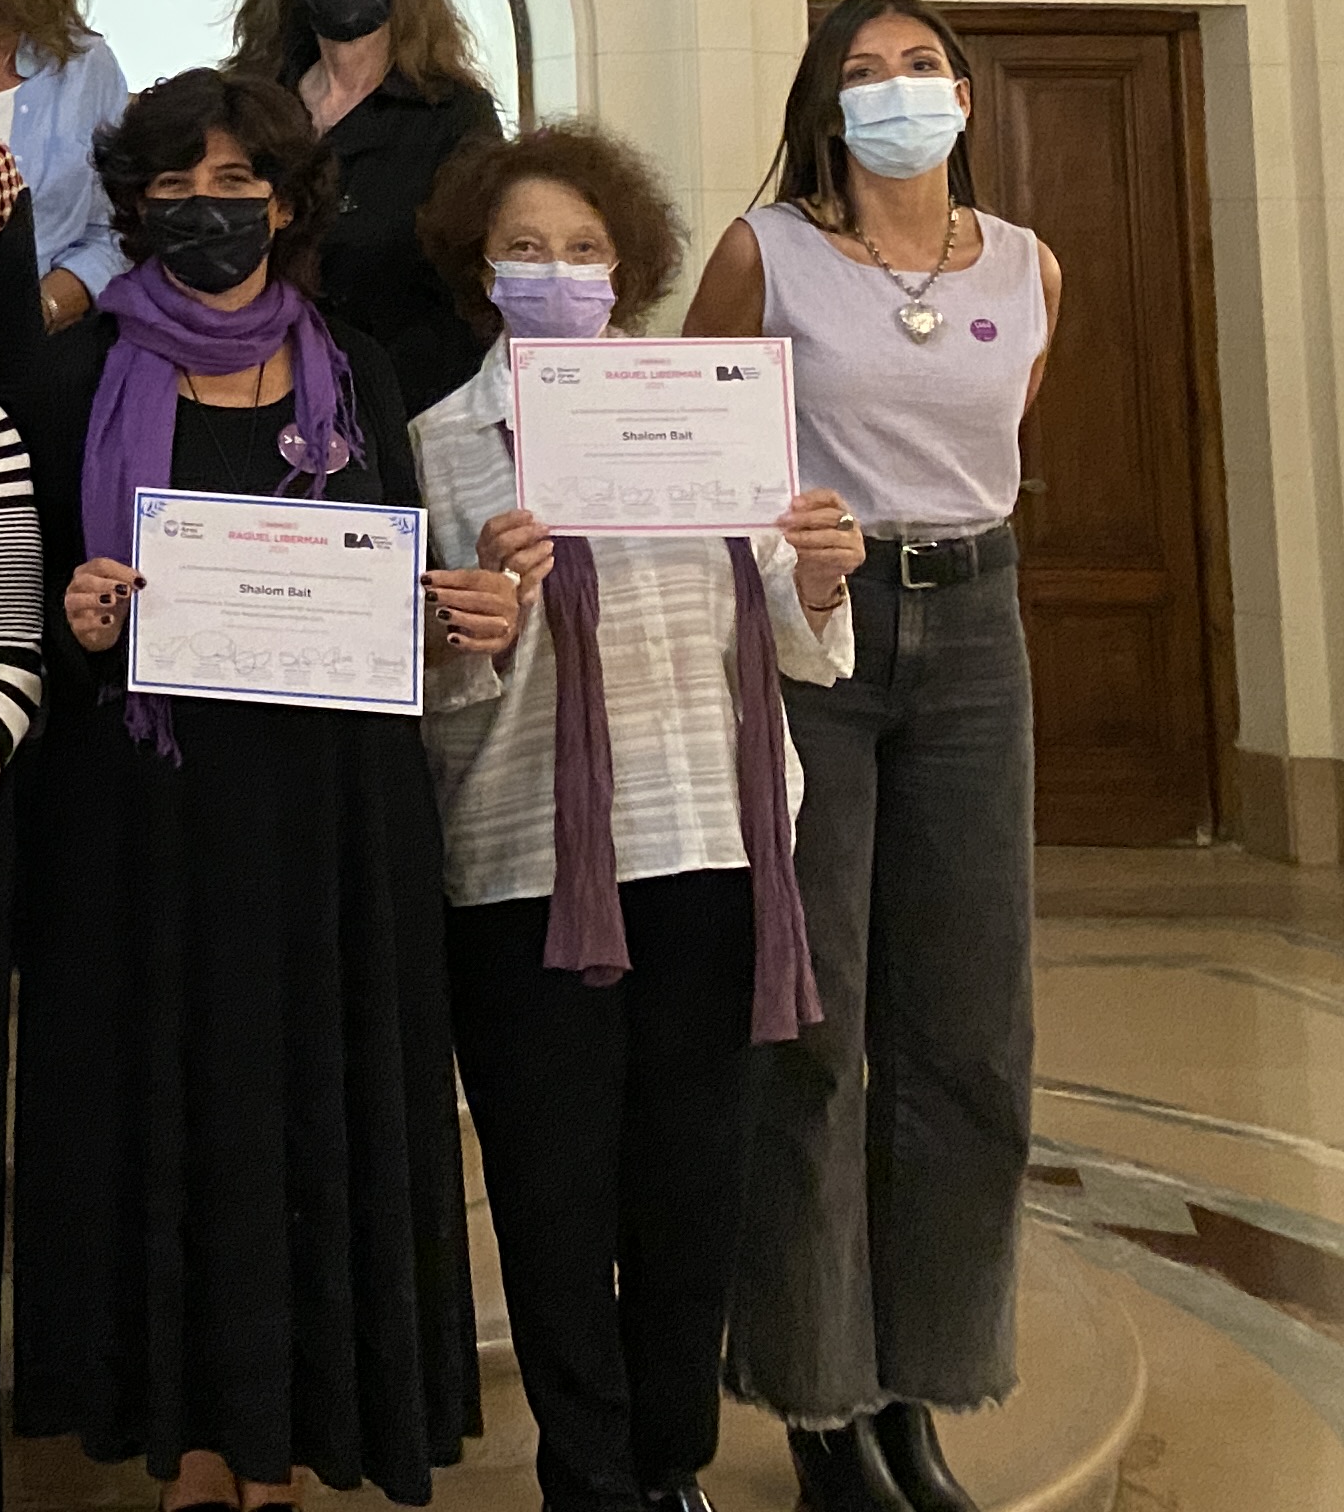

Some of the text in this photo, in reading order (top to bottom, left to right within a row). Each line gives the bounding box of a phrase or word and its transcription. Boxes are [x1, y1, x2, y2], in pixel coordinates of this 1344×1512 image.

[716, 365, 744, 381] BA
[622, 431, 693, 441] Shalom Bait
[344, 533, 374, 549] BA
[239, 583, 312, 598] Shalom Bait
